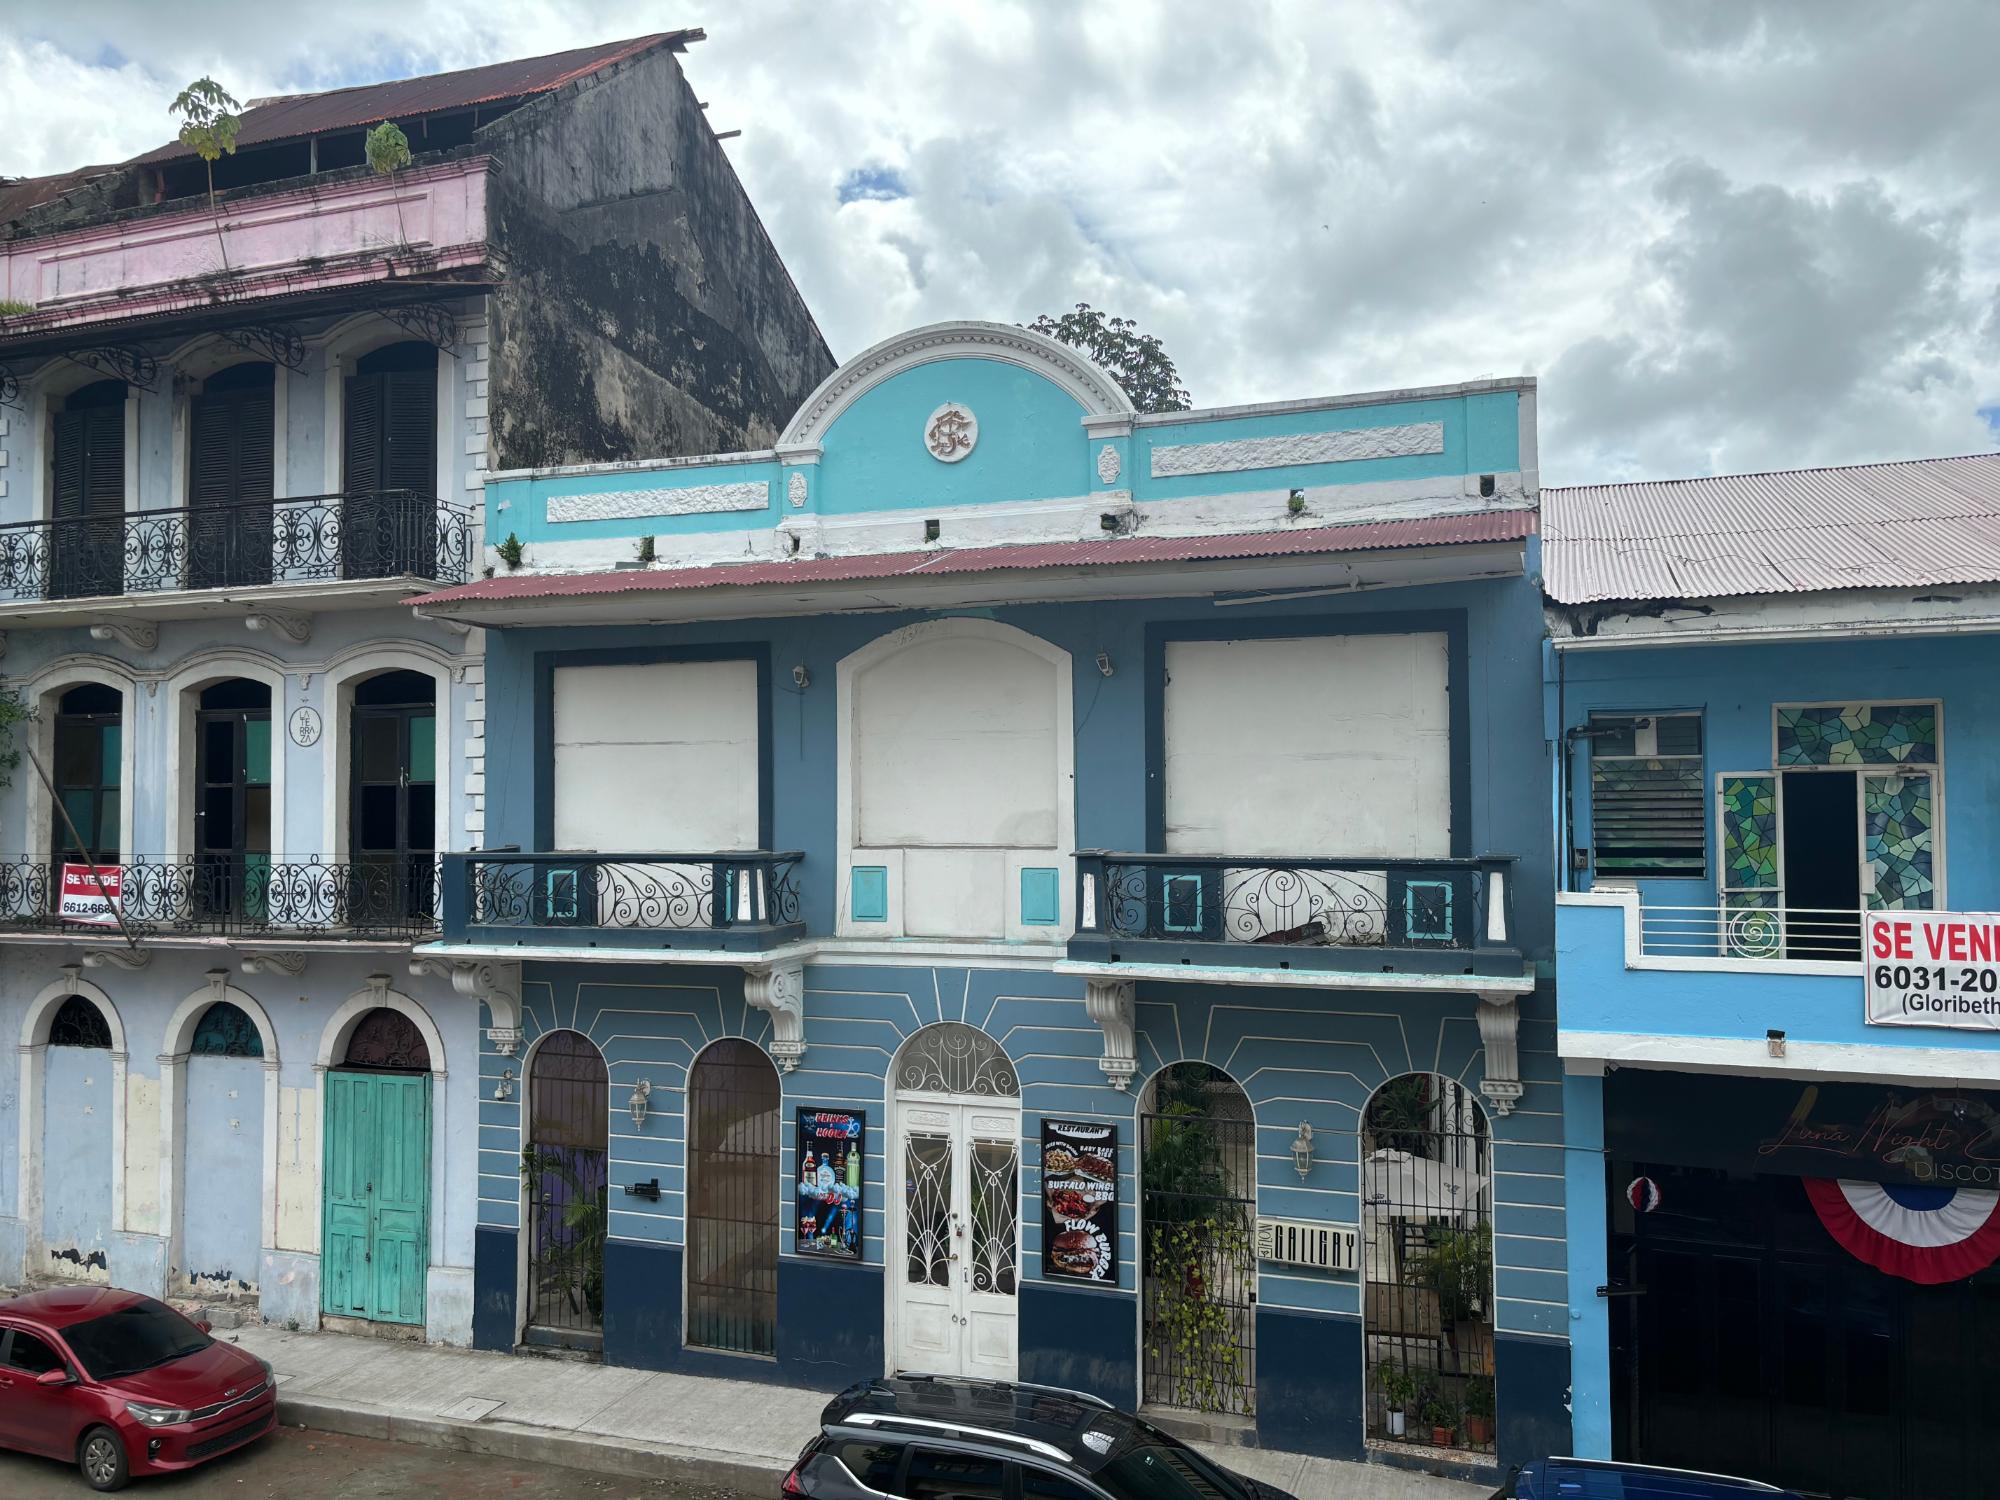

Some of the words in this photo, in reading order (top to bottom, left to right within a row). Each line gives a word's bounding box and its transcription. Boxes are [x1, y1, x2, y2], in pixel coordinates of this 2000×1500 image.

[66, 874, 80, 884] SE
[1873, 922, 1914, 959] SE
[1875, 965, 2000, 992] 6031-20
[1057, 1125, 1104, 1135] RESTAURANT
[1852, 1094, 1958, 1162] Night
[1048, 1181, 1086, 1190] BUFFALO
[1064, 1218, 1100, 1234] FLOW
[1258, 1222, 1272, 1247] FLOW
[1275, 1224, 1355, 1268] GALLERY
